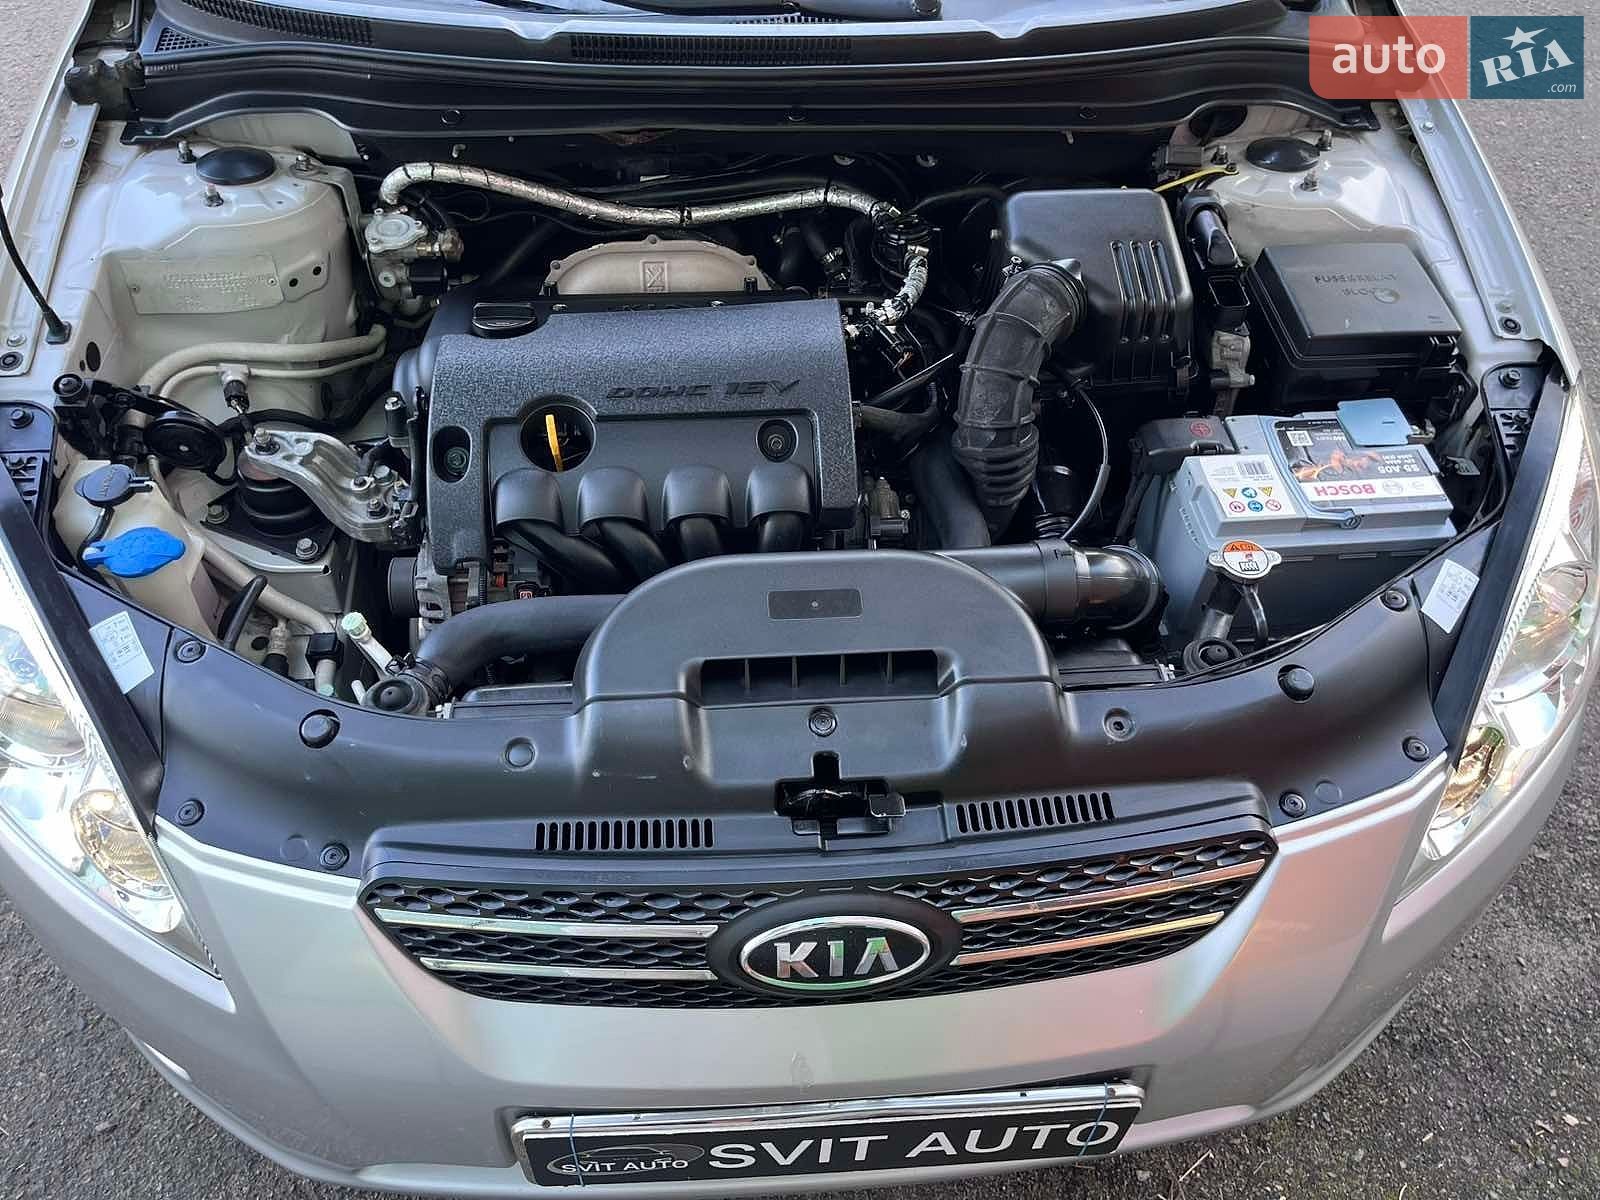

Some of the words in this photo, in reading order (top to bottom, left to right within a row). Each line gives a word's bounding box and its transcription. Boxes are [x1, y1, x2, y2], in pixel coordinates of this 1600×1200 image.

[606, 384, 713, 399] DOHC
[1313, 483, 1376, 497] BOSCH
[774, 936, 899, 978] KIA
[707, 1134, 889, 1169] SVIT
[904, 1121, 1120, 1159] AUTO
[562, 1162, 616, 1173] SVIT
[623, 1160, 689, 1172] AUTO
